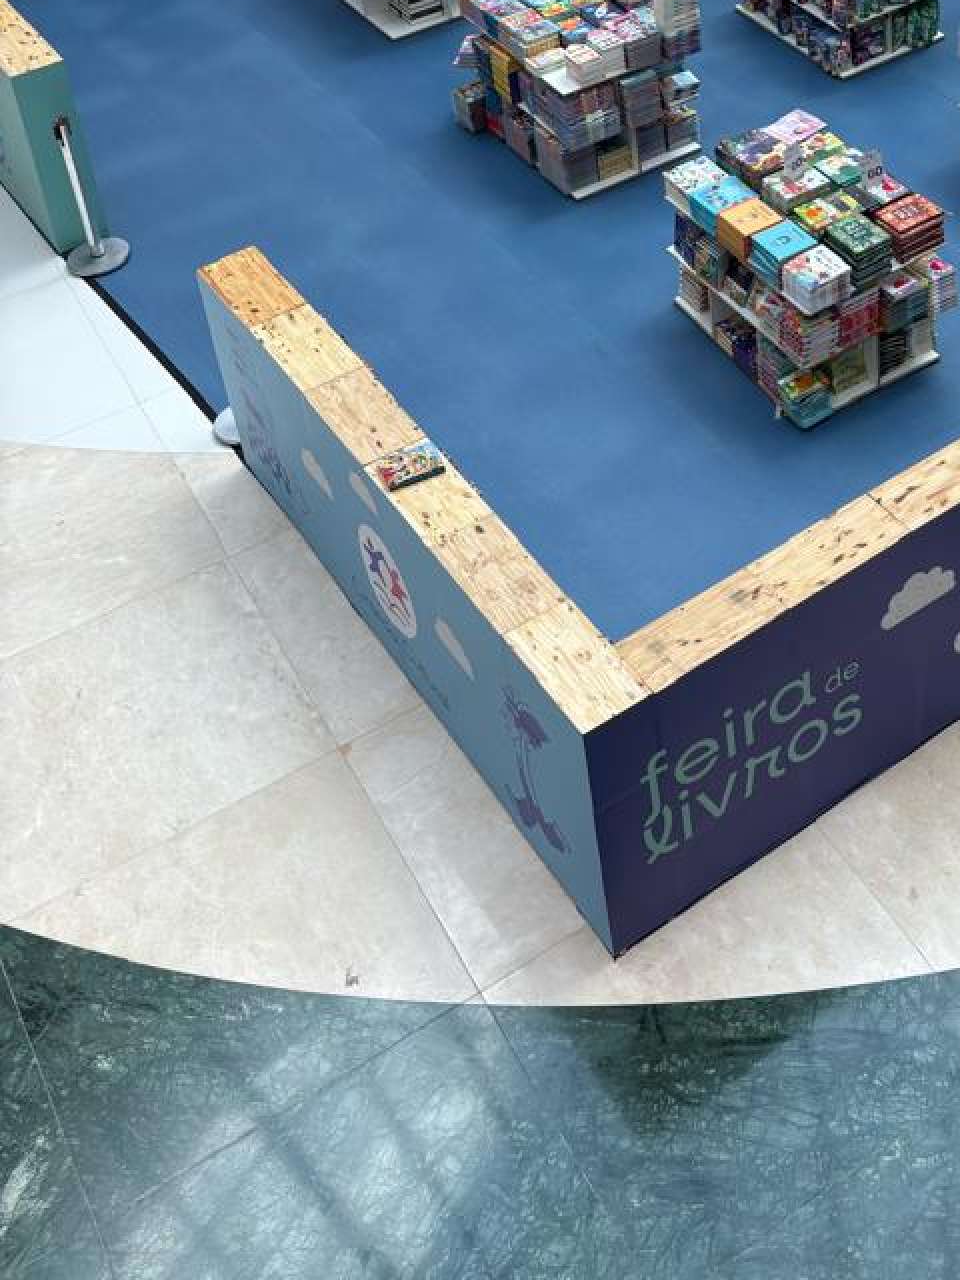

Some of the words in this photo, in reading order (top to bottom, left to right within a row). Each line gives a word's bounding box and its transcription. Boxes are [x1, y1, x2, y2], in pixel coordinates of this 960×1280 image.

[640, 668, 817, 828] feira
[824, 659, 860, 694] de
[642, 693, 863, 865] livros
